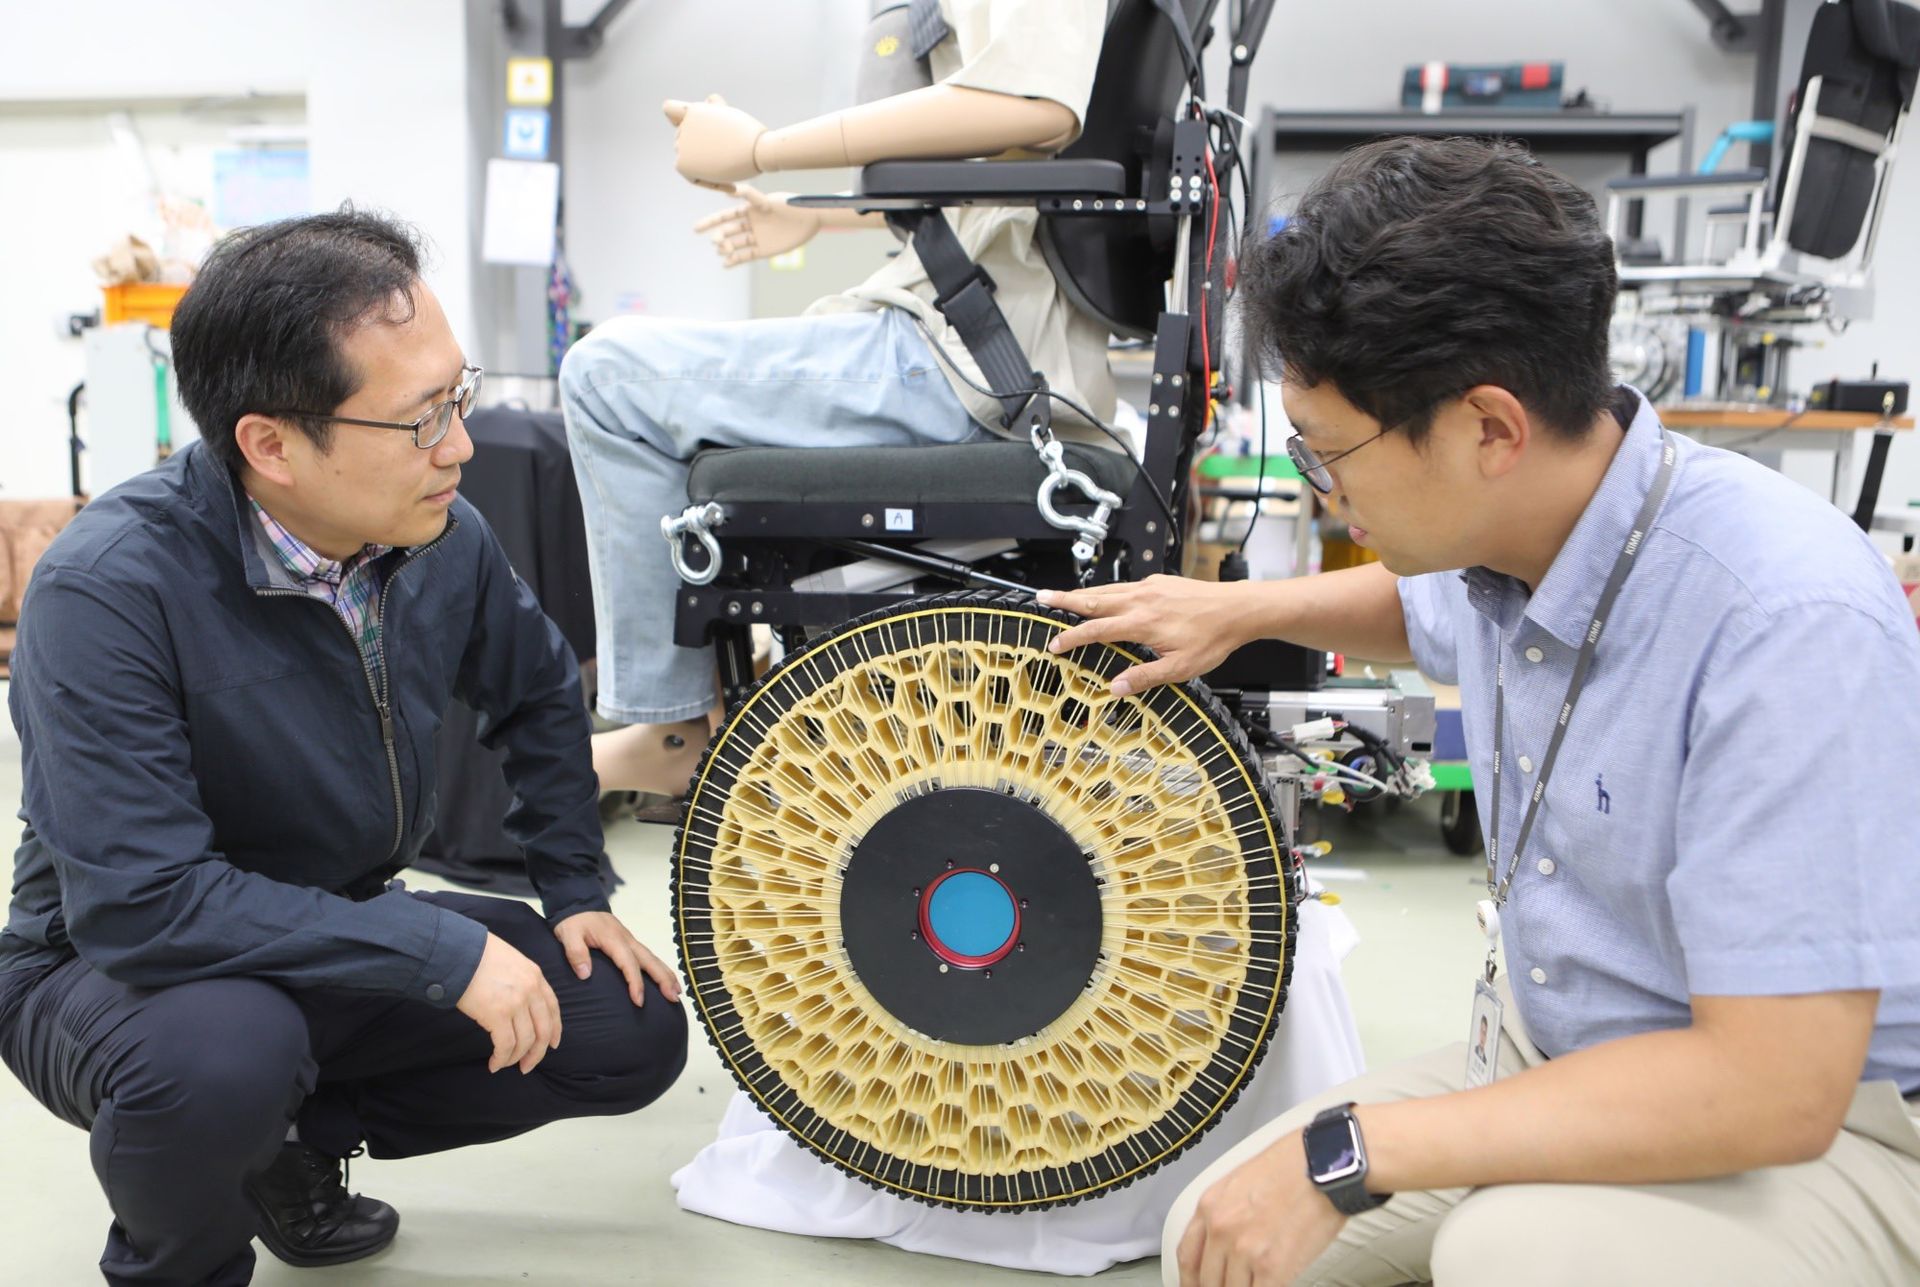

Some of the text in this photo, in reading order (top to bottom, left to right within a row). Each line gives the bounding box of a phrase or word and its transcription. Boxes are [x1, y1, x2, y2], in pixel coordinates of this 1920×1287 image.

[1624, 530, 1643, 555] KIMM
[1587, 619, 1602, 644] KIMM
[1559, 702, 1572, 726] KIMM
[1533, 780, 1545, 803] KIMM
[1510, 854, 1519, 875] KIMM
